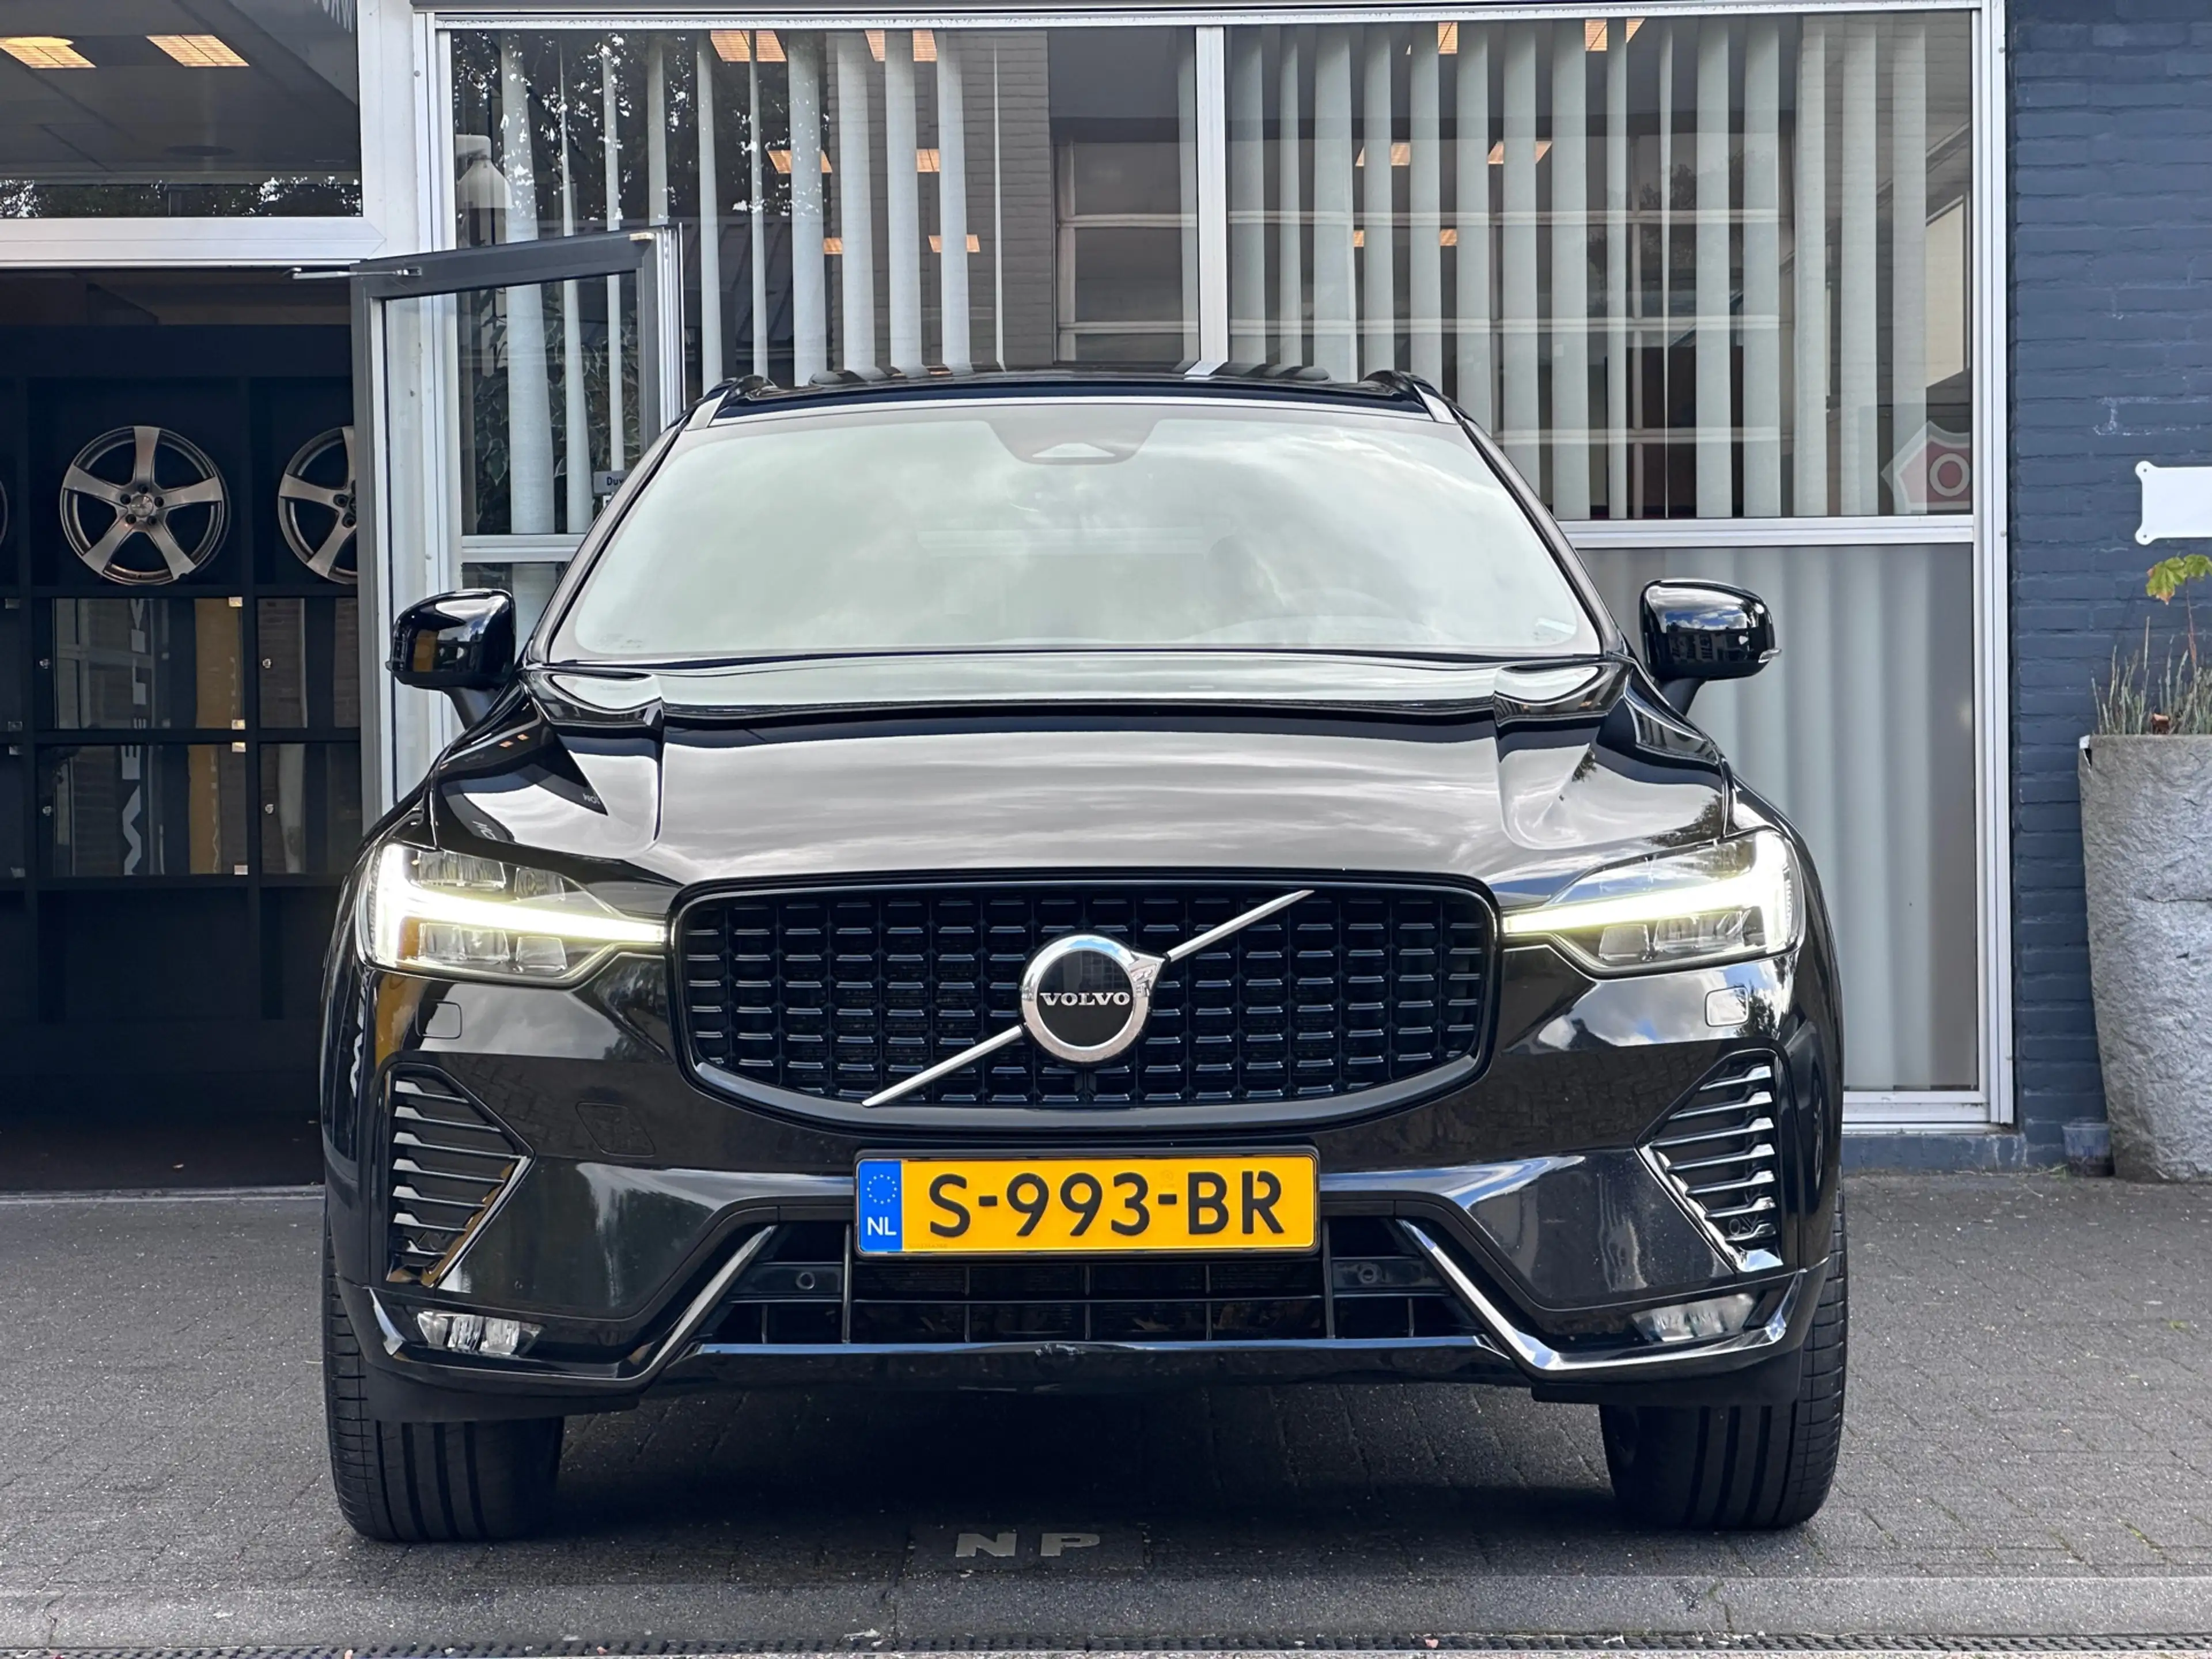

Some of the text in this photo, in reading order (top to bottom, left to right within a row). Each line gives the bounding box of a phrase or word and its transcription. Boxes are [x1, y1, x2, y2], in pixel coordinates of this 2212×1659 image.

[1040, 992, 1130, 1006] VOLVO
[930, 1172, 1283, 1237] S-993-BR
[868, 1217, 897, 1236] NL
